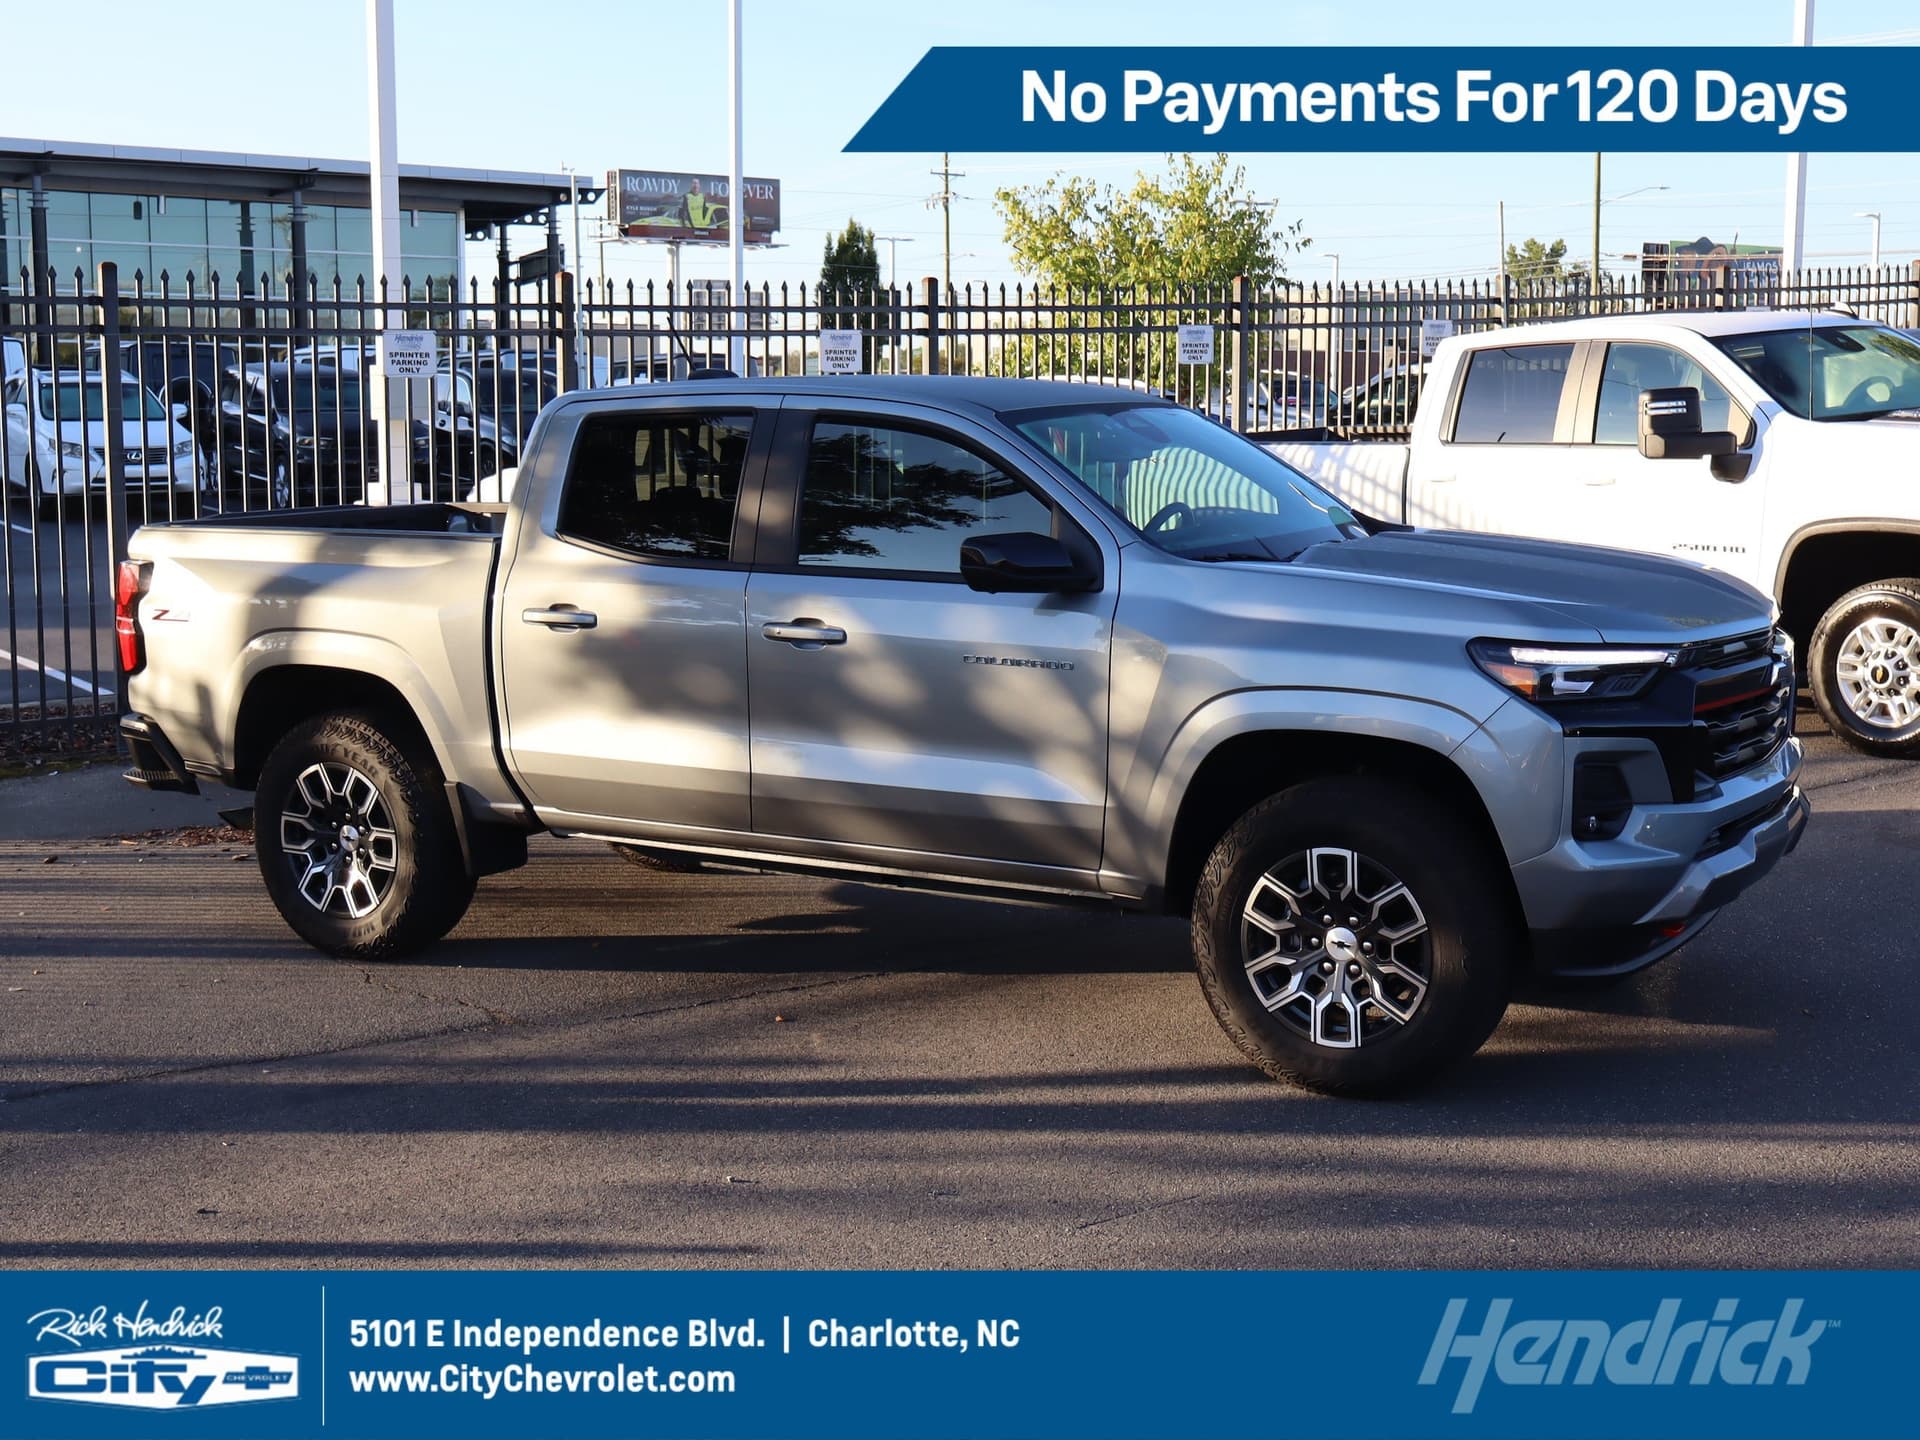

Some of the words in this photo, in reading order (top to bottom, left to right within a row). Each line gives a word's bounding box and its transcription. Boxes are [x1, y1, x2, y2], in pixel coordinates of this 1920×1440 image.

[626, 176, 680, 194] ROWDY
[710, 181, 774, 200] FOEVER
[389, 351, 430, 359] SPRINTER
[962, 654, 1075, 671] COLORADO
